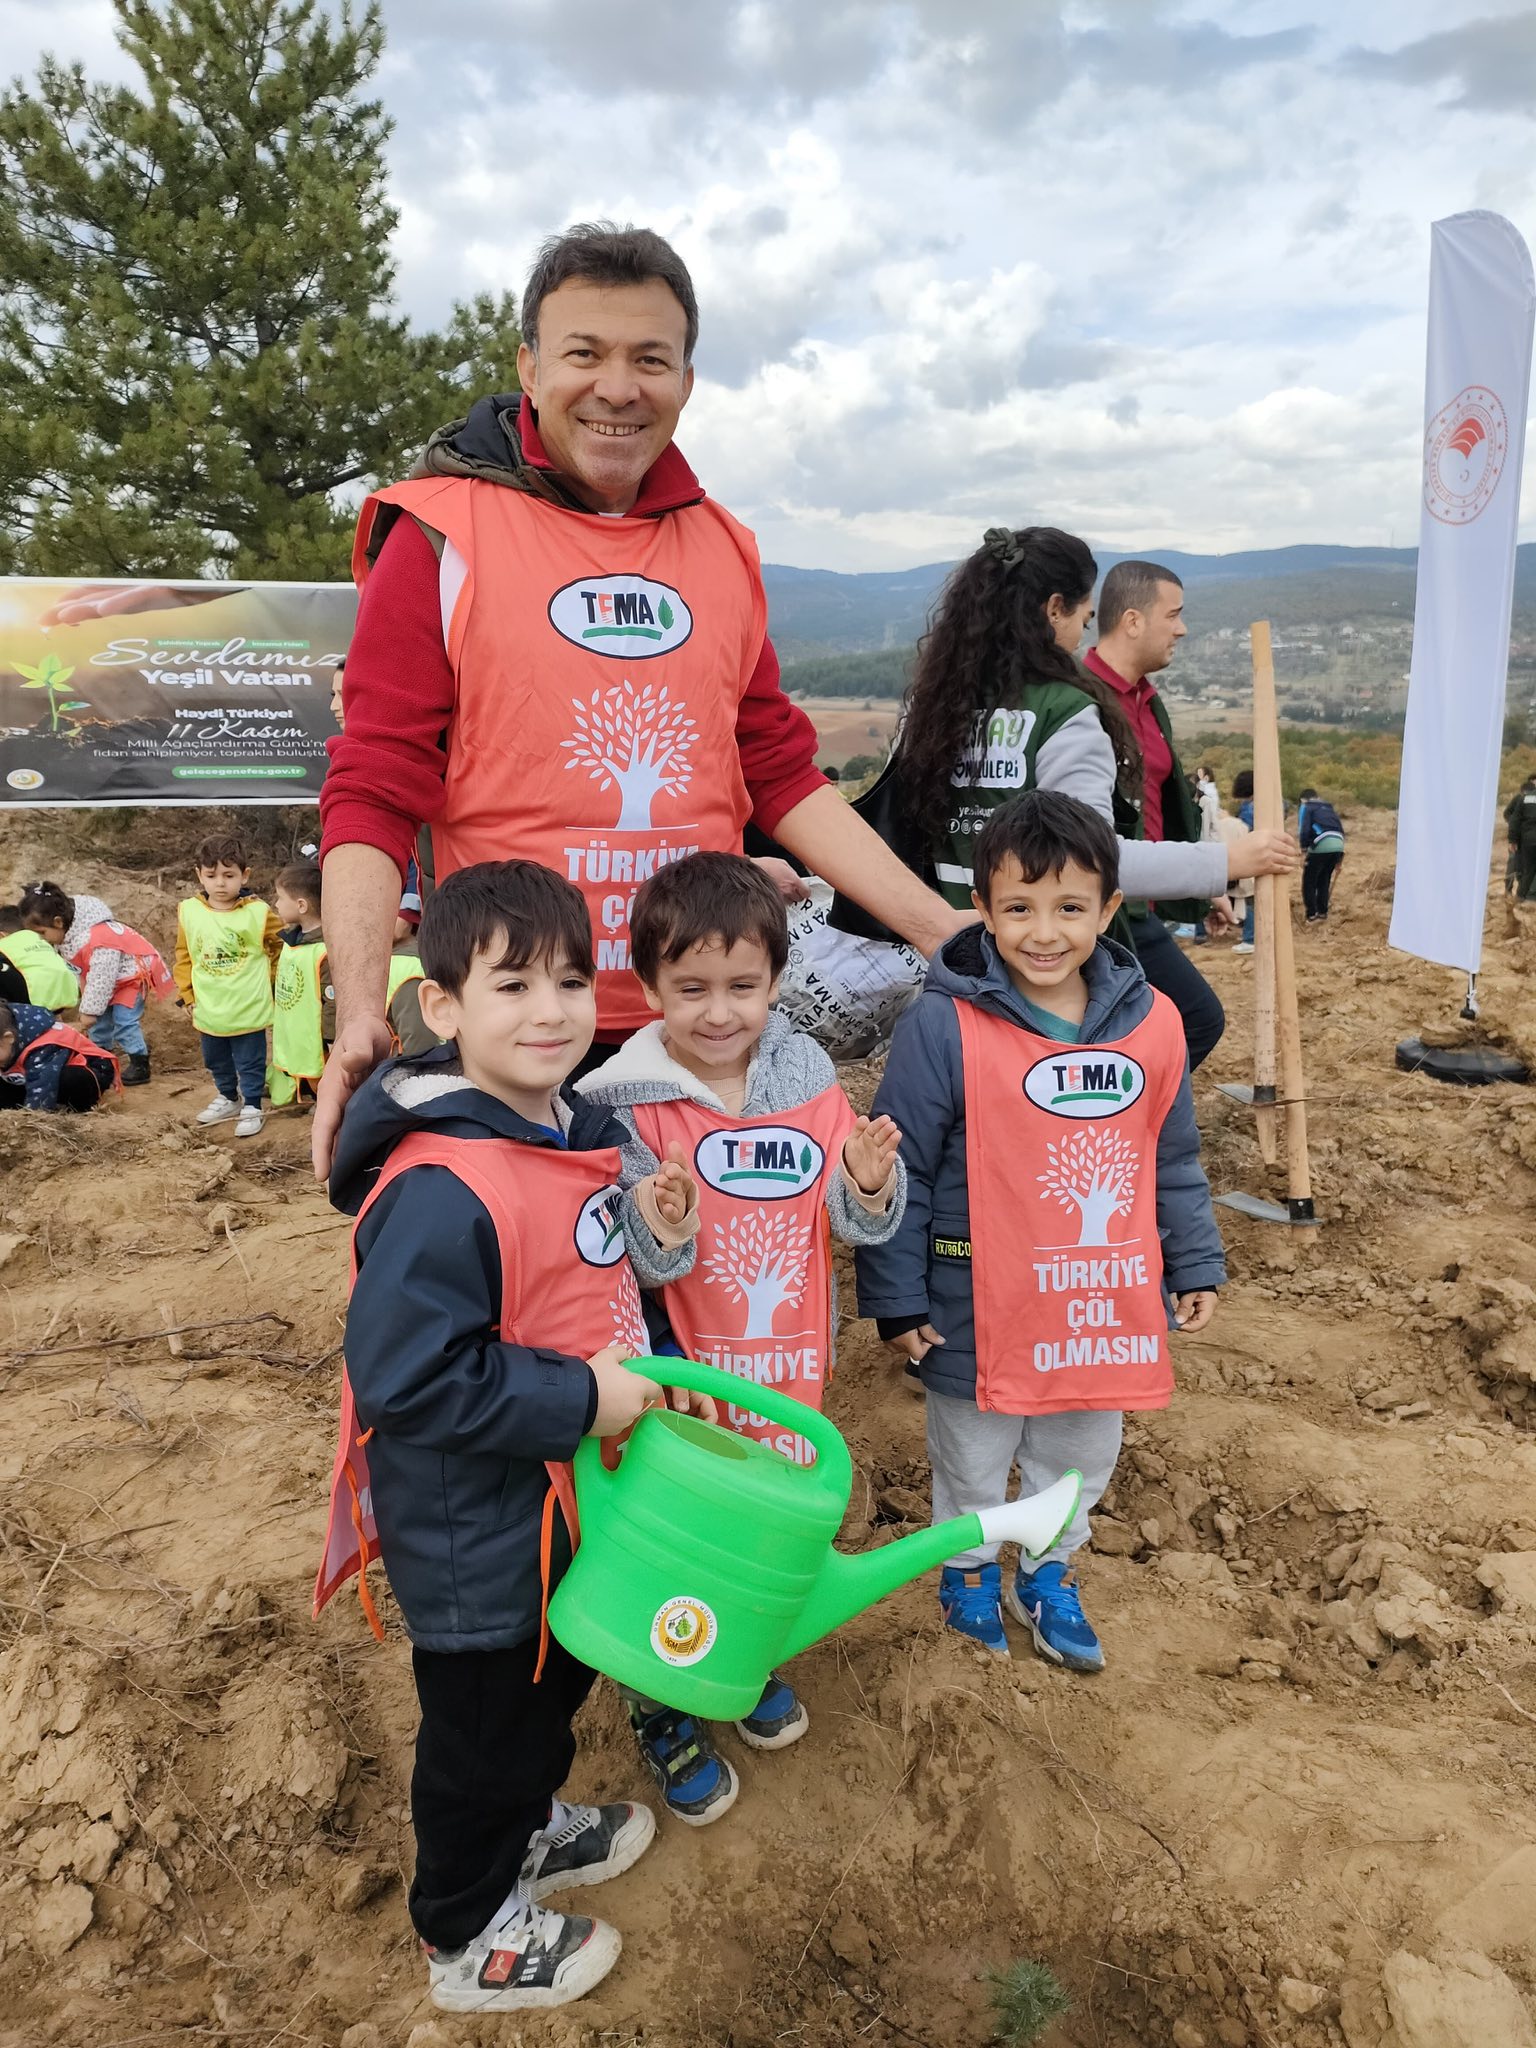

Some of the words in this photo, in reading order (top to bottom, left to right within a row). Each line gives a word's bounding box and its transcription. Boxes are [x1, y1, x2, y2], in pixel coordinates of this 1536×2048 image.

[581, 591, 655, 625] TEMA
[89, 637, 346, 668] Sevdamız
[139, 669, 213, 688] Yeşil
[219, 670, 312, 686] Vatan
[175, 708, 224, 720] Haydi
[167, 723, 191, 738] 11
[198, 718, 308, 739] Kasım
[93, 749, 129, 757] fidan
[132, 749, 217, 758] sahipleniyor,
[220, 749, 273, 758] toprakla
[128, 739, 156, 748] Milli
[161, 740, 266, 750] Ağaçlandırma
[1052, 1063, 1117, 1091] TEMA
[722, 1139, 796, 1169] TEMA
[1032, 1252, 1149, 1293] TÜRKİYE
[1067, 1292, 1122, 1335] ÇÖL
[1033, 1335, 1159, 1373] OLMASIN
[664, 1636, 678, 1652] OGM
